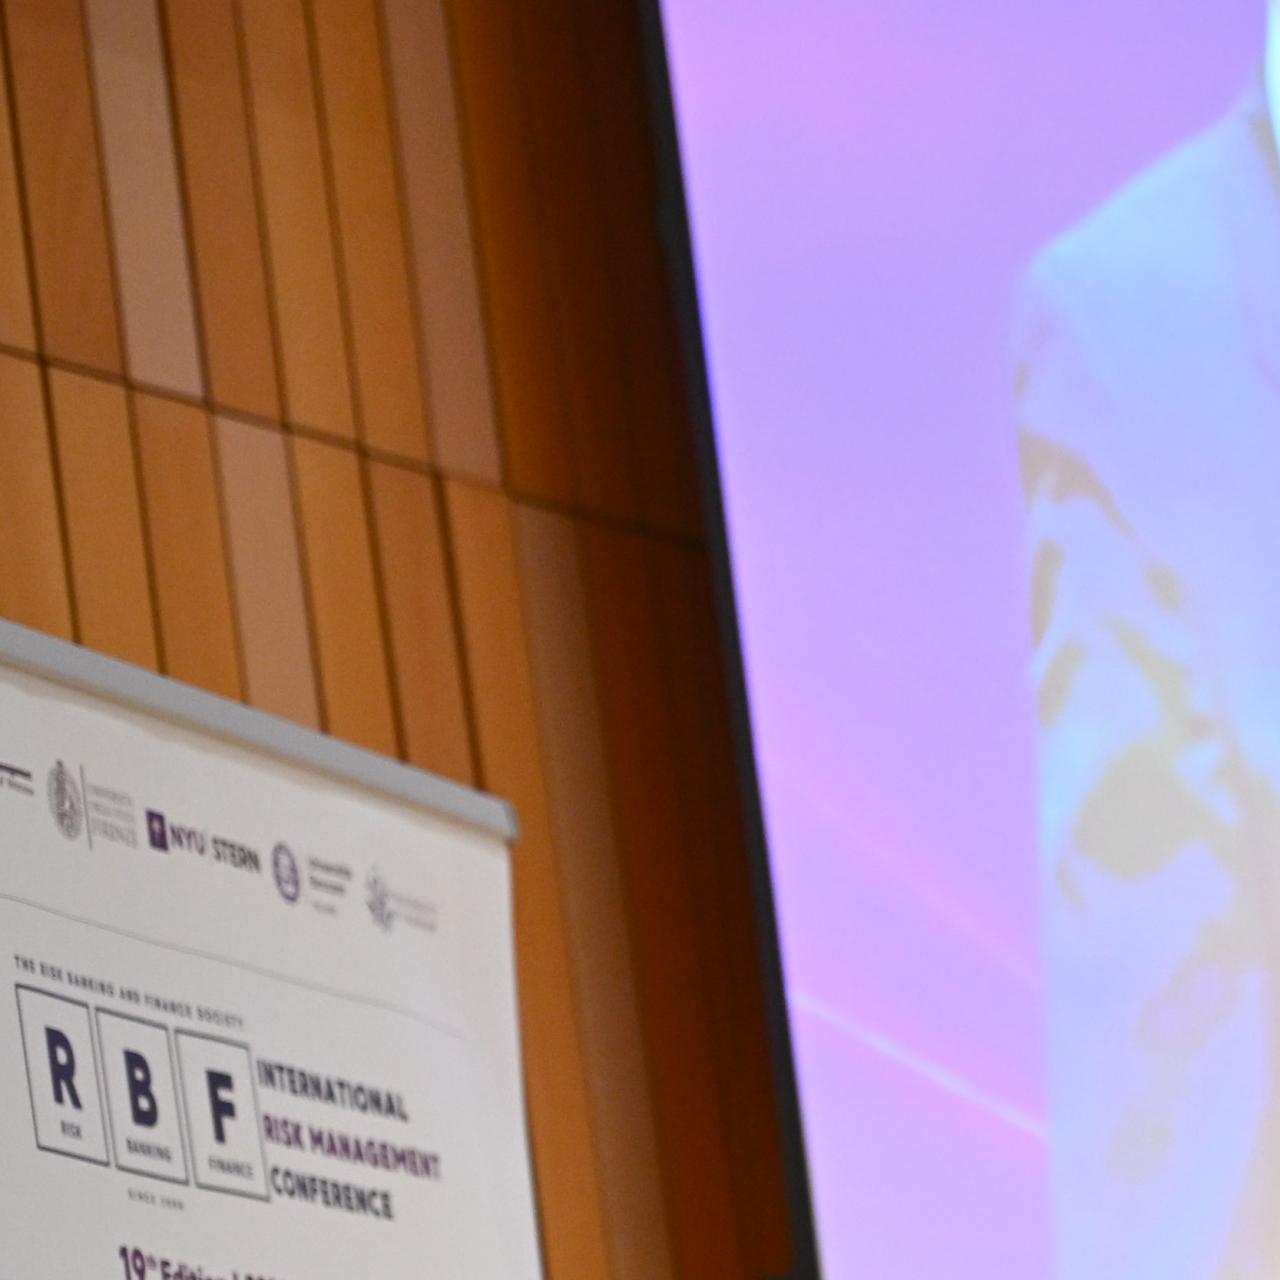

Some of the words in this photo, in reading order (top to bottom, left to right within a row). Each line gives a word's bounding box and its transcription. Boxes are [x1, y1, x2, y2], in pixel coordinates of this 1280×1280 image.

[168, 822, 206, 856] NYU
[211, 836, 262, 873] STERN
[14, 953, 37, 976] THE
[39, 962, 64, 982] RISK
[44, 1026, 83, 1110] R
[123, 1049, 158, 1129] B
[205, 1069, 236, 1144] F
[256, 1058, 410, 1123] INTERNATIONAL
[60, 1119, 83, 1139] RISK
[263, 1113, 303, 1150] RISK
[308, 1125, 441, 1183] MANAGEMENT
[270, 1165, 395, 1222] CONFERENCE
